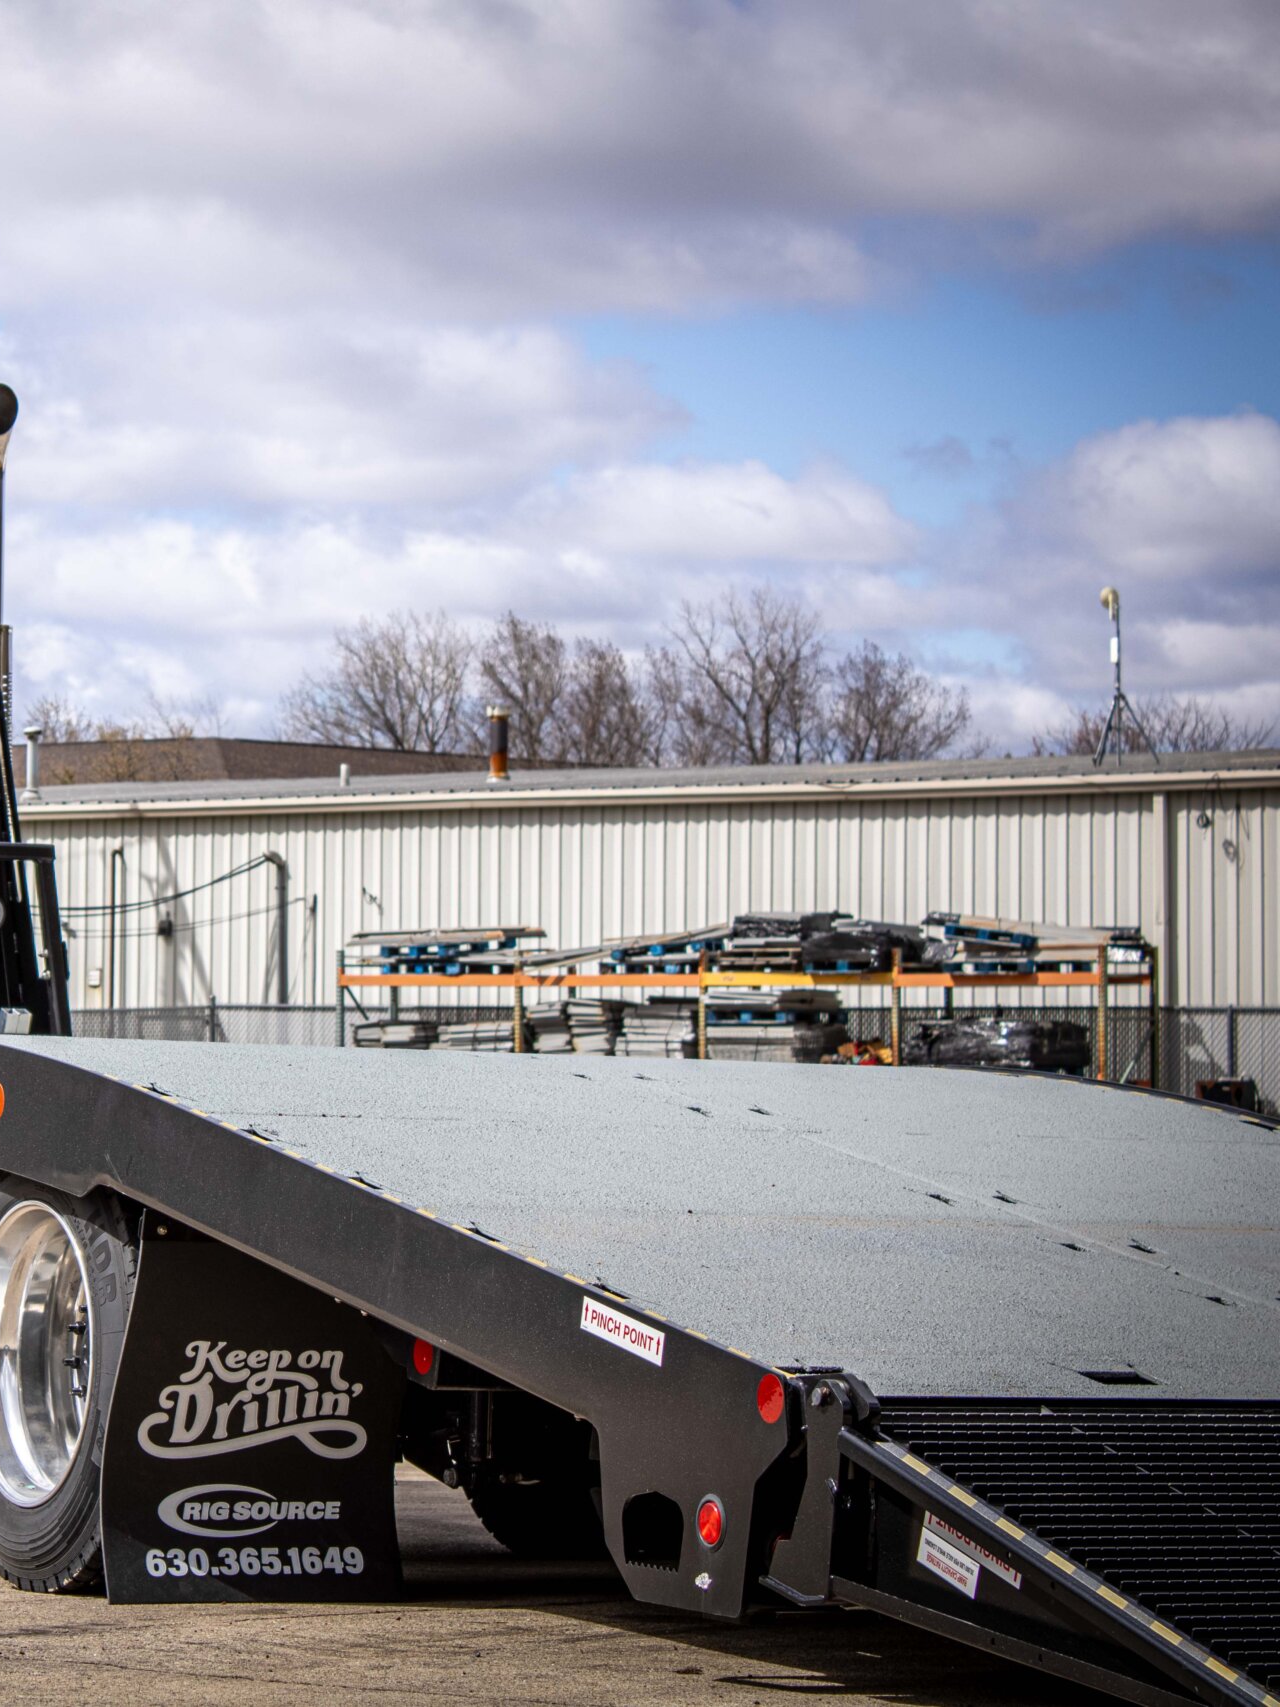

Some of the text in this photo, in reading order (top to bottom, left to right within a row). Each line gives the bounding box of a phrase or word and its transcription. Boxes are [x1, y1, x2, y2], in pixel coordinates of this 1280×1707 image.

[591, 1309, 654, 1352] PINCH POINT
[179, 1340, 349, 1394] Keep on
[182, 1501, 341, 1521] RIG SOURCE
[145, 1546, 365, 1577] 630.365.1649
